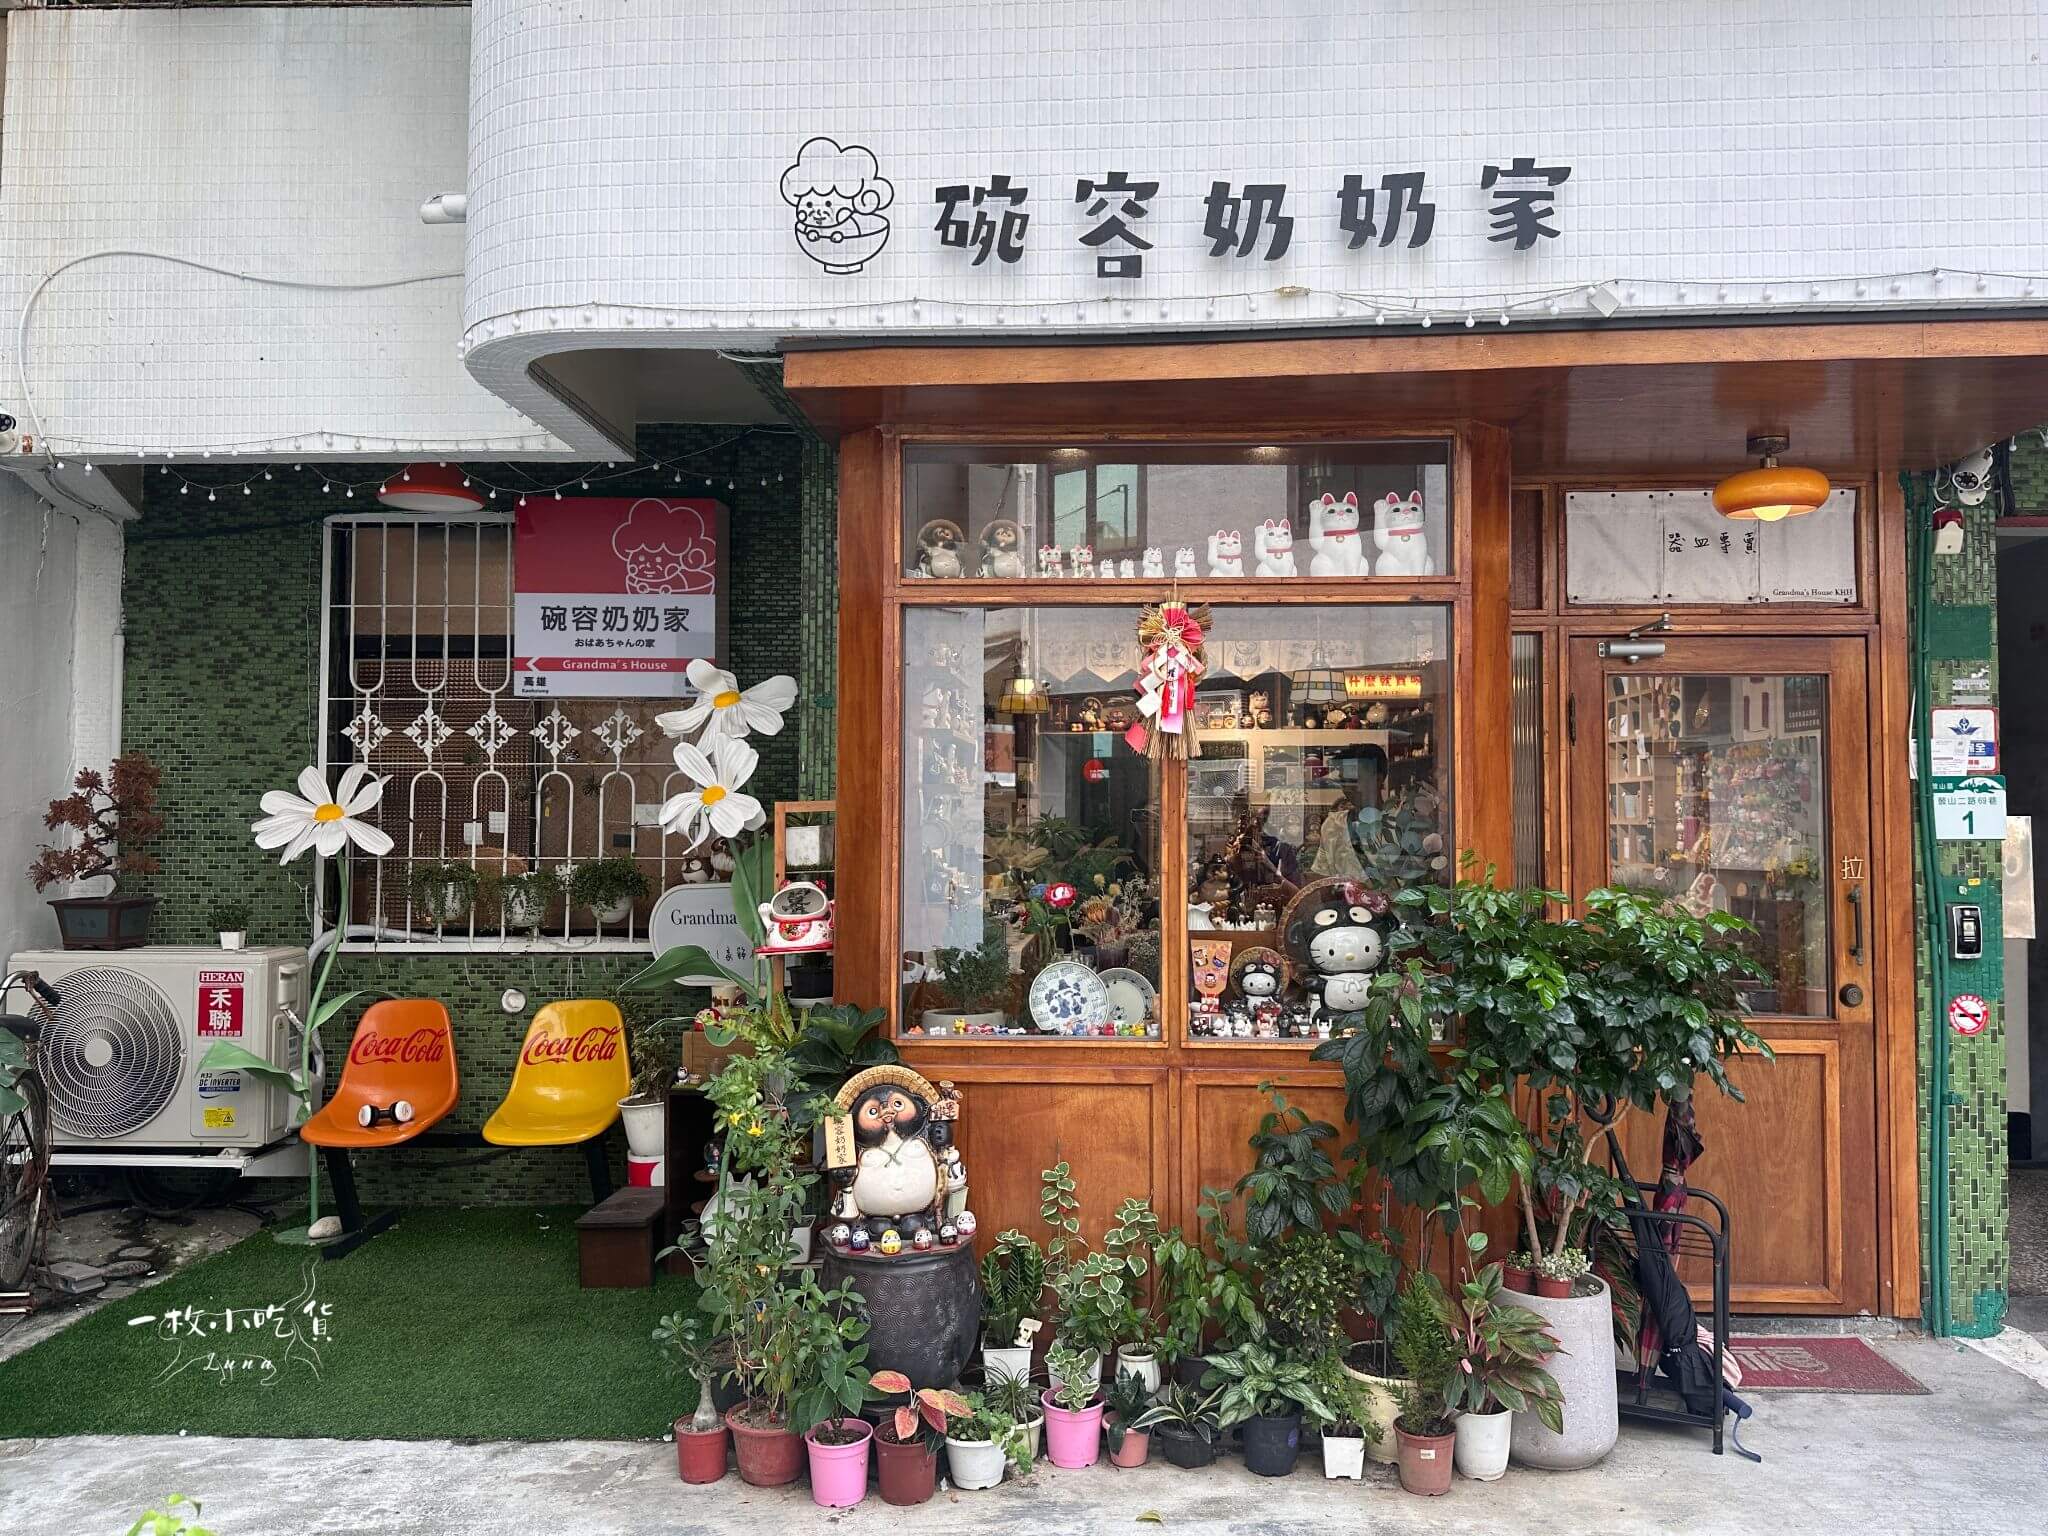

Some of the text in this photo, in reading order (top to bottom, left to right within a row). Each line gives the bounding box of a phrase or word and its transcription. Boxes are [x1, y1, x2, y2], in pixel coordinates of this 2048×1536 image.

[935, 157, 1572, 279] 碗容奶奶家
[1811, 588, 1833, 596] House
[540, 605, 690, 633] 碗容奶奶家
[631, 660, 668, 670] House
[523, 676, 547, 687] 高雄
[1962, 810, 1974, 835] 1
[1841, 855, 1864, 881] 拉
[200, 972, 243, 982] HERAN
[208, 988, 232, 1031] 禾聯
